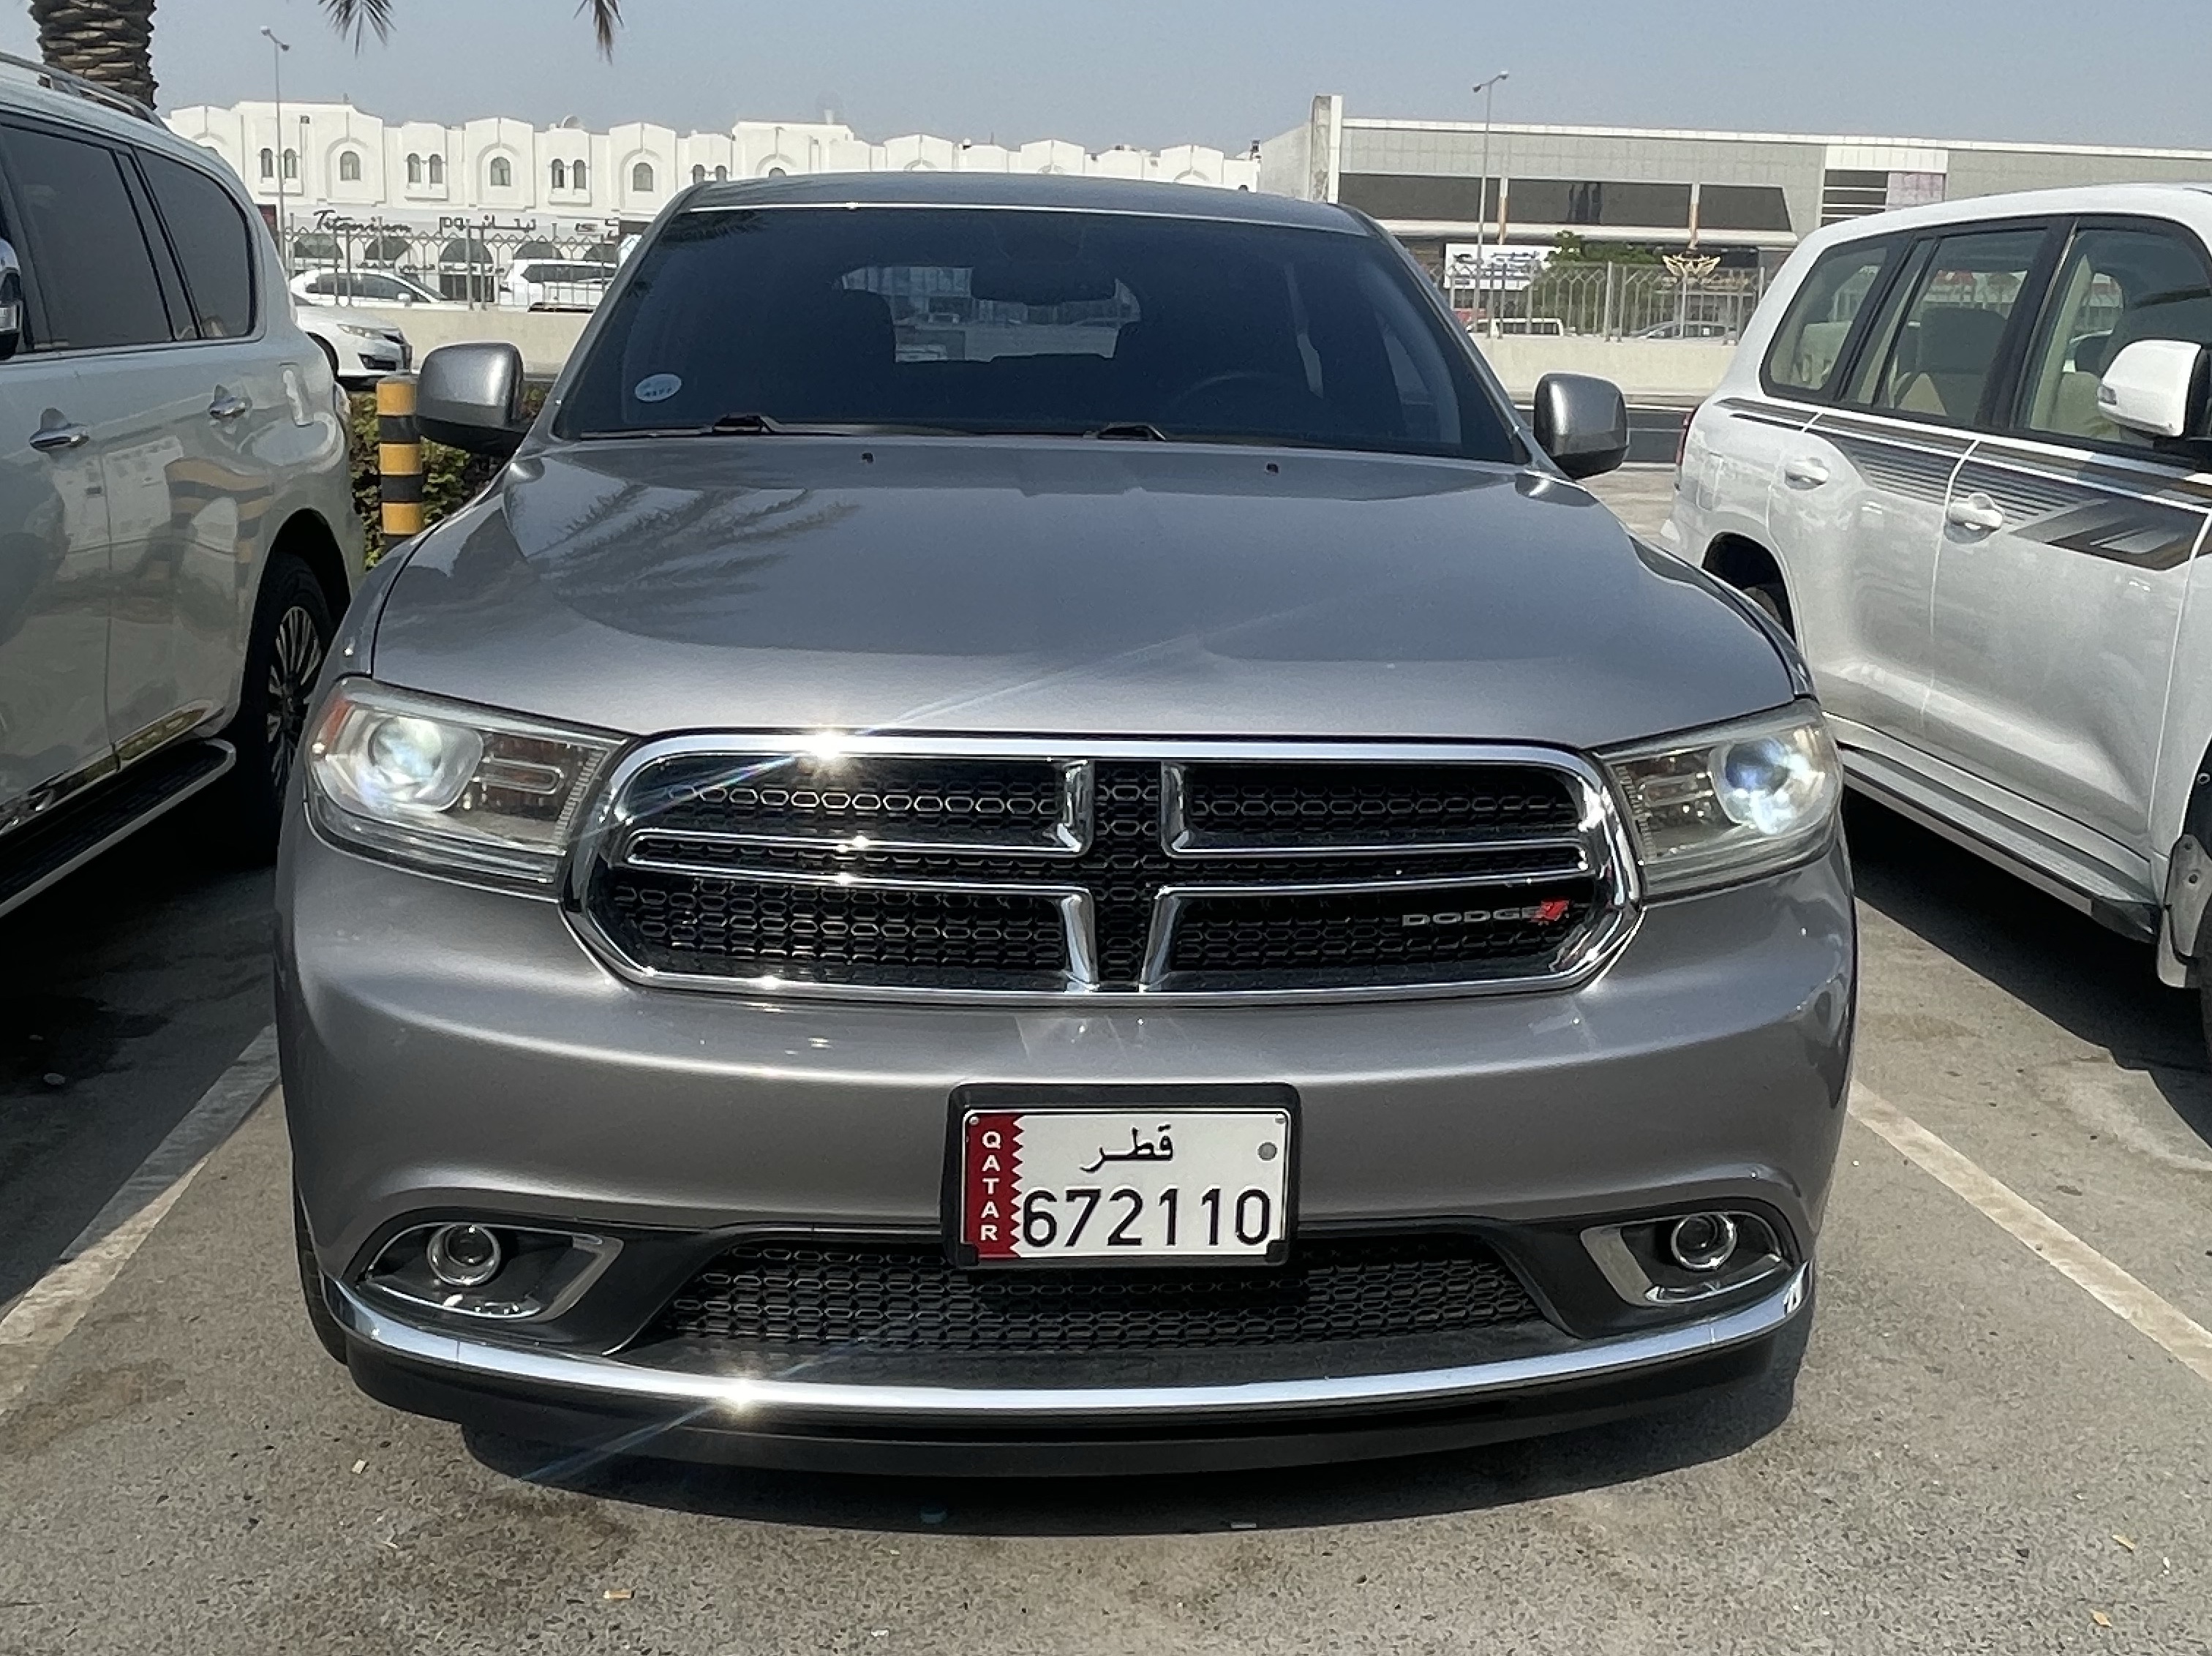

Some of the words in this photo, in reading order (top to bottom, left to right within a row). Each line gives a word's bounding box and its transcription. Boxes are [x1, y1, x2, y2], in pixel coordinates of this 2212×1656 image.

[1402, 906, 1540, 927] DODGE
[1079, 1124, 1174, 1173] قطر
[980, 1131, 1002, 1242] QATAR
[1023, 1188, 1271, 1247] 672110
